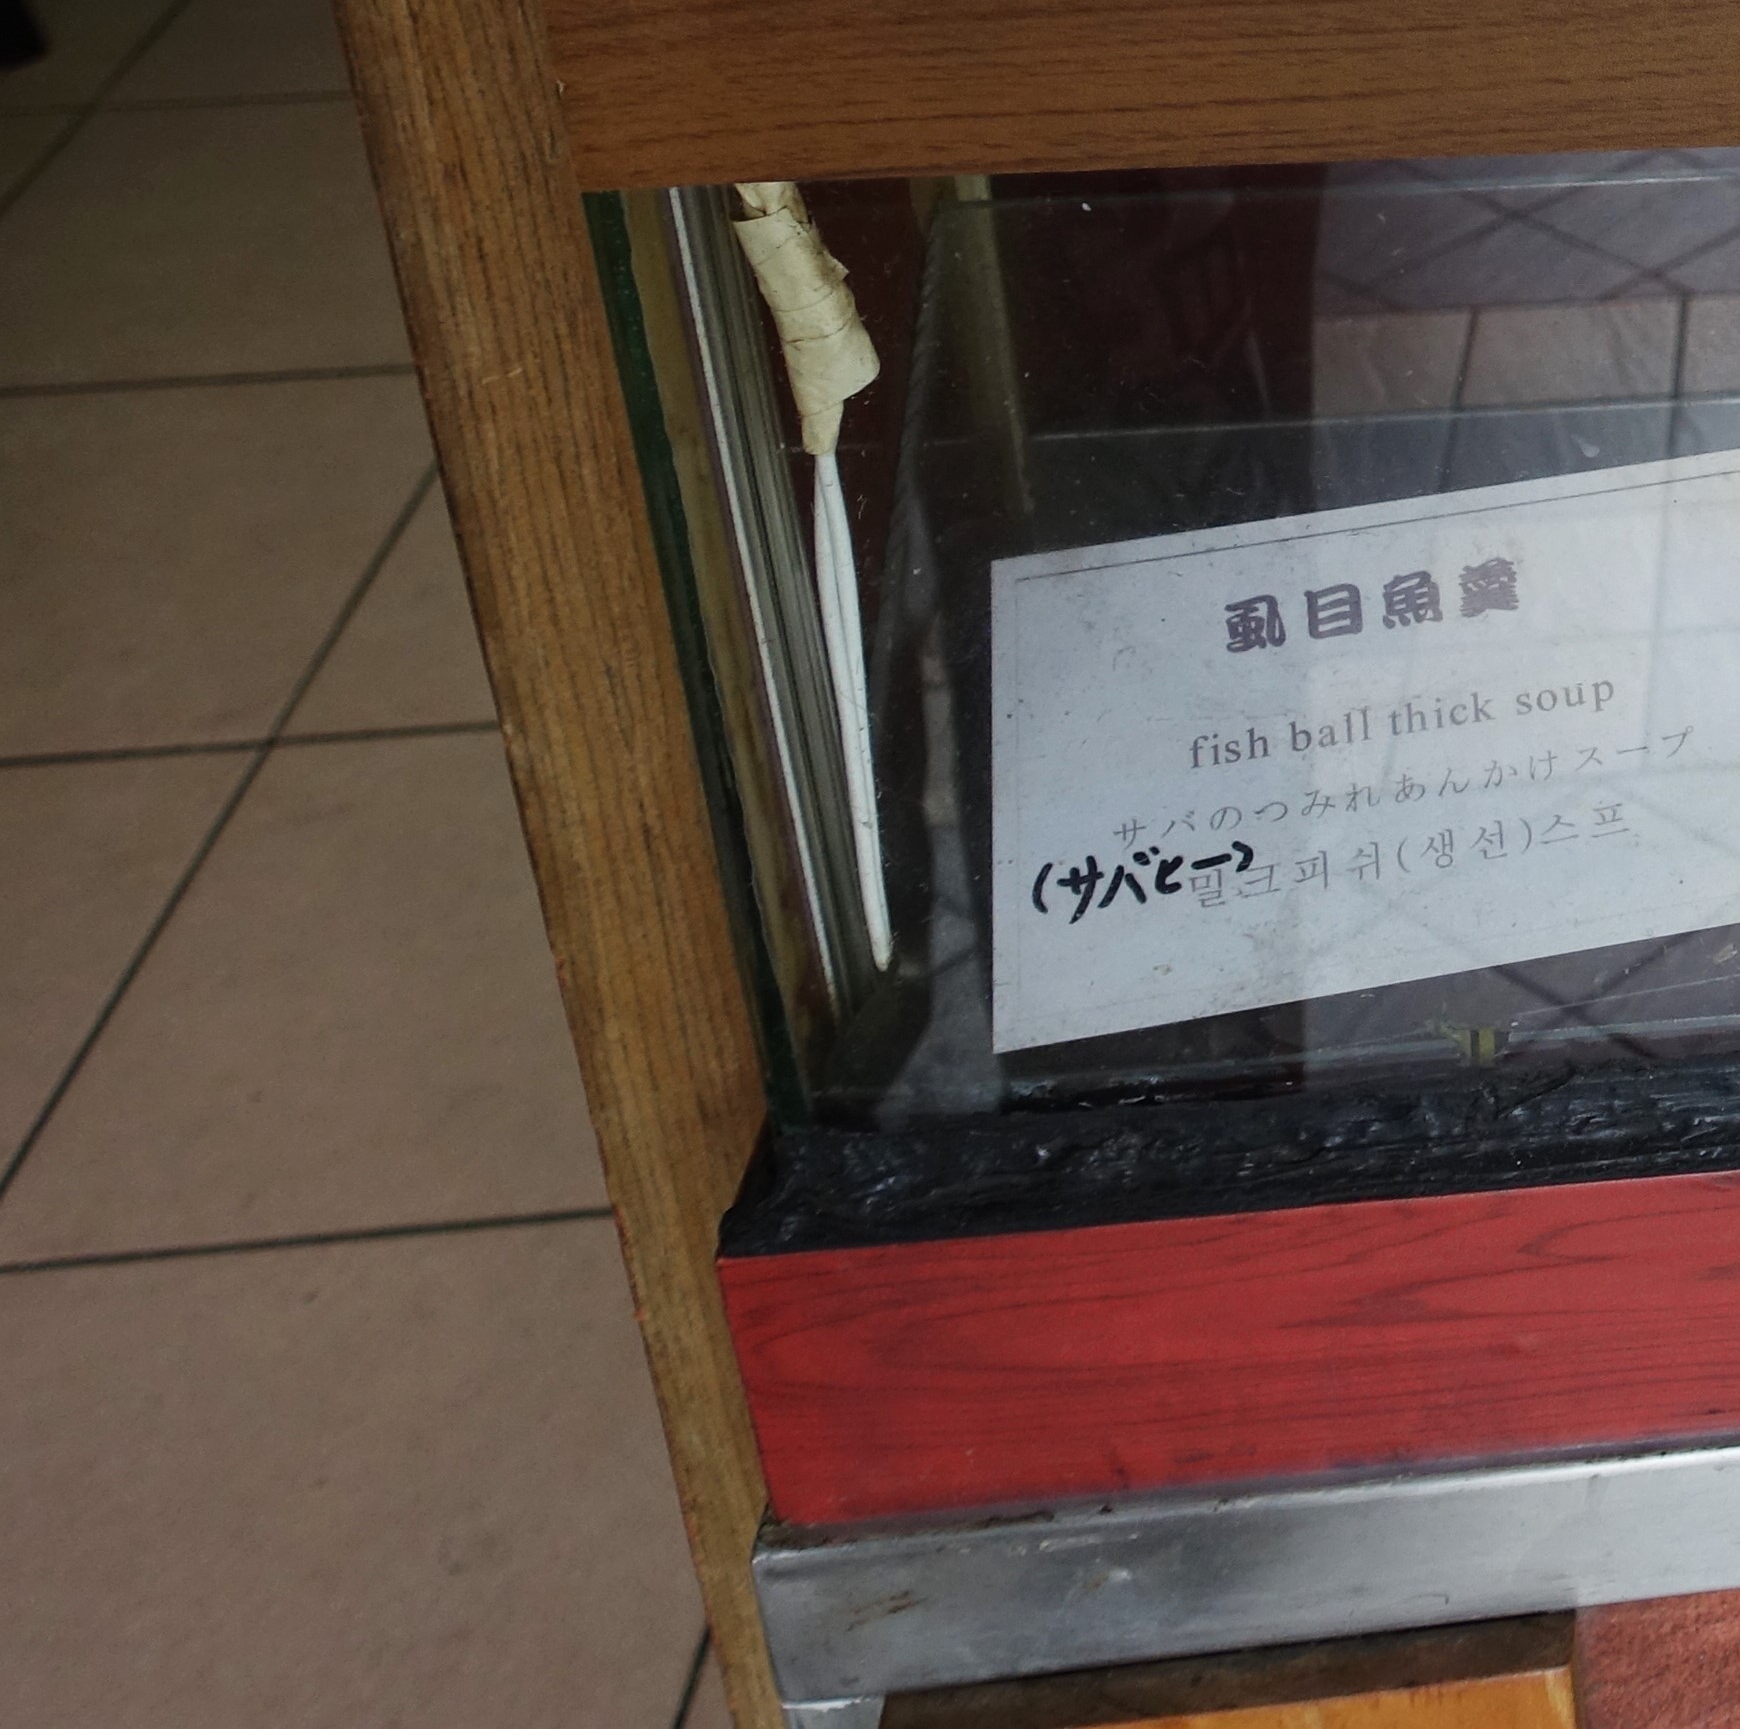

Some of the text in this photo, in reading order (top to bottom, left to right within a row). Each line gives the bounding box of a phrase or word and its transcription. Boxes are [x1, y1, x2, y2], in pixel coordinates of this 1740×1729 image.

[1188, 679, 1616, 770] fish ball thick soup
